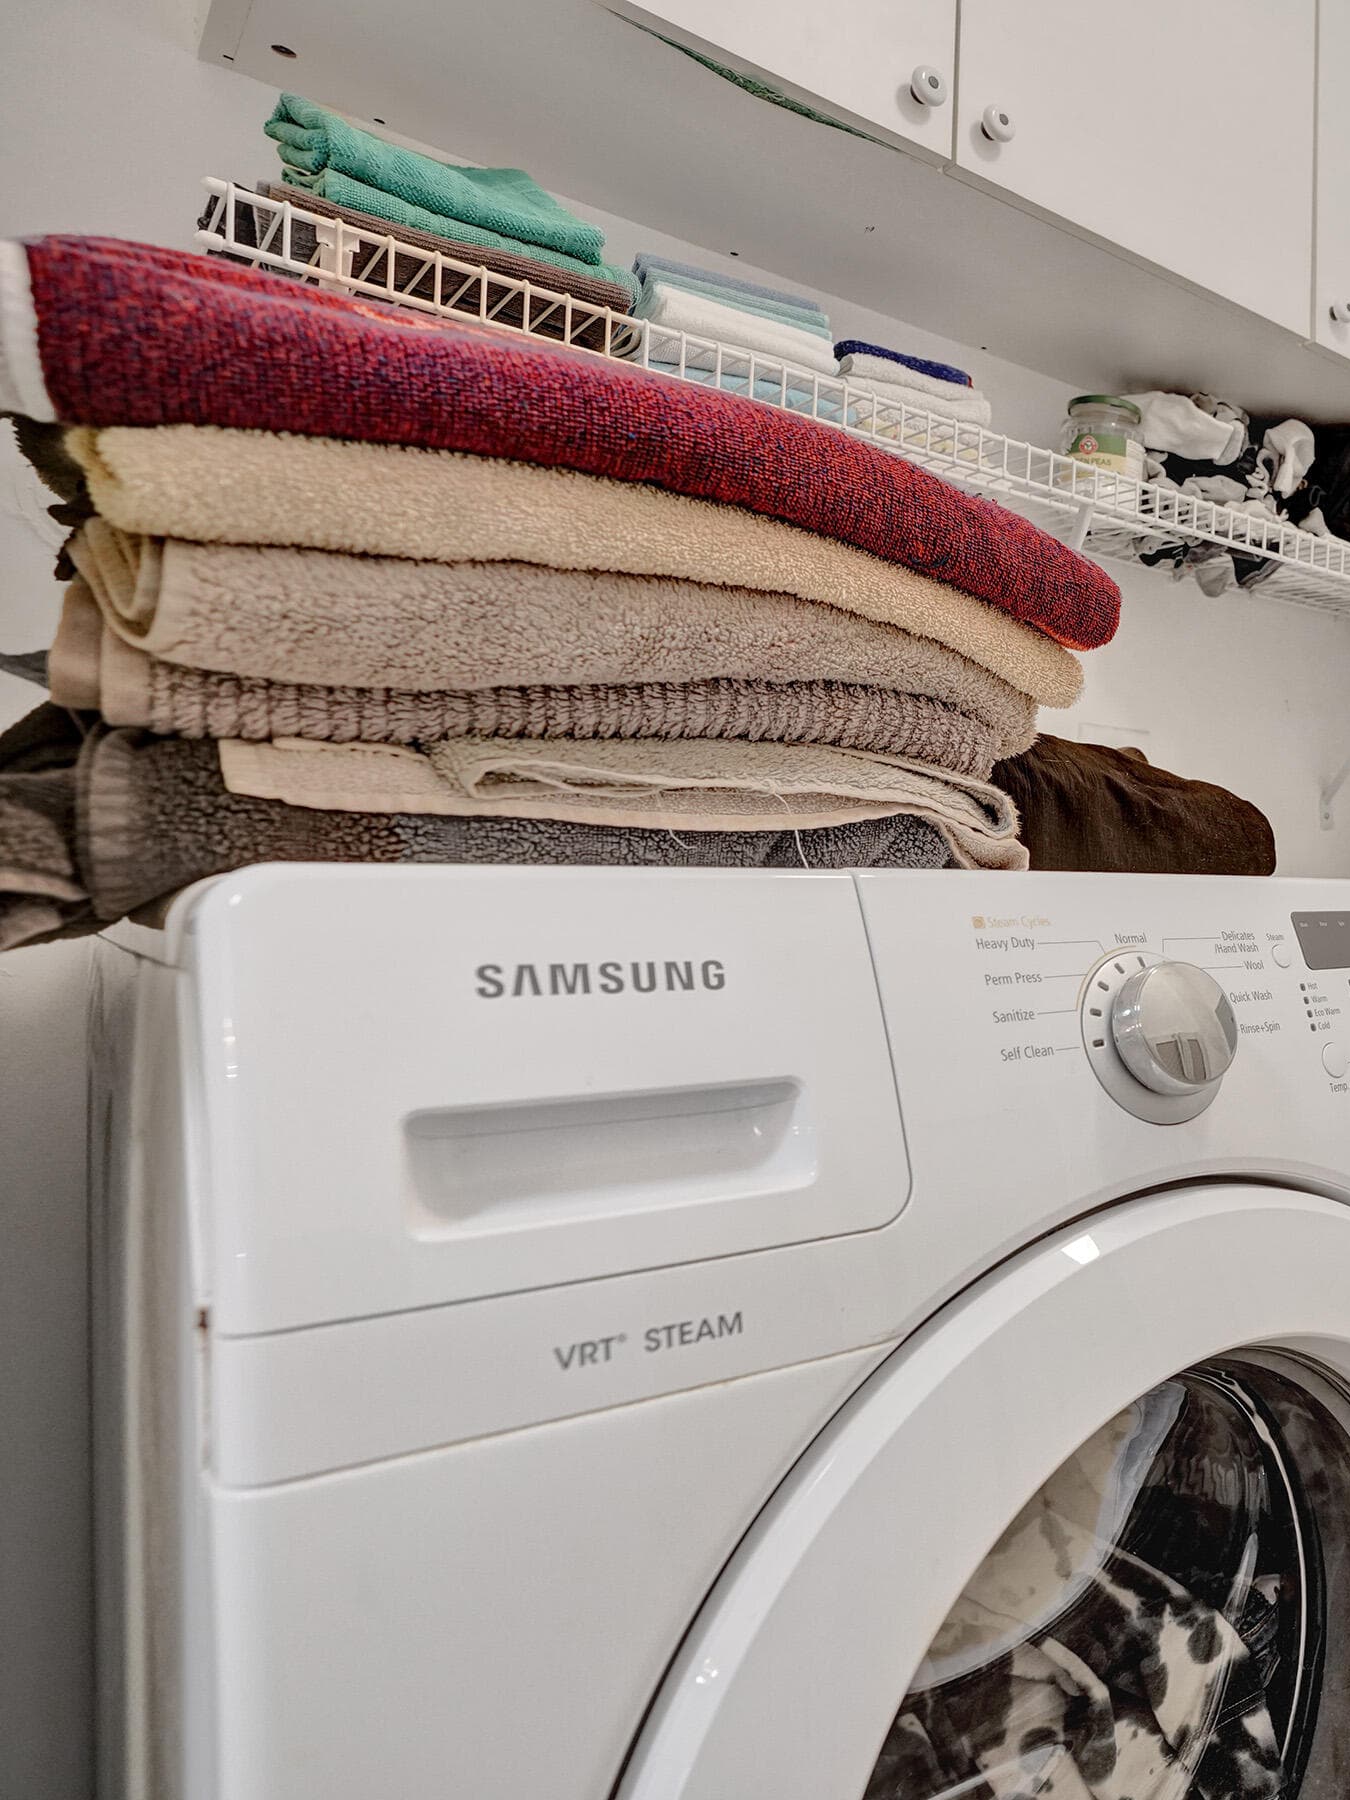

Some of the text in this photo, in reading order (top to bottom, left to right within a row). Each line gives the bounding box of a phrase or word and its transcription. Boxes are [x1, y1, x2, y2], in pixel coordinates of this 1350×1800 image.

[1114, 933, 1147, 944] Normal
[1221, 931, 1255, 941] Delicates
[1266, 933, 1284, 941] Steam
[976, 936, 1036, 951] Heavy Duty
[1215, 943, 1259, 954] /Hand Wash
[1244, 960, 1264, 970] Wool
[475, 959, 726, 999] SAMSUNG
[984, 972, 1042, 986] Perm Press
[1230, 991, 1273, 1004] Quick Wash
[1311, 995, 1328, 1003] Warm
[992, 1009, 1036, 1024] Sanitize
[1314, 1008, 1341, 1017] Eco Warm
[1240, 1022, 1281, 1034] Rinse+Spin
[1318, 1021, 1330, 1030] Cold
[1000, 1045, 1054, 1062] Self Clean
[644, 1311, 743, 1352] STEAM
